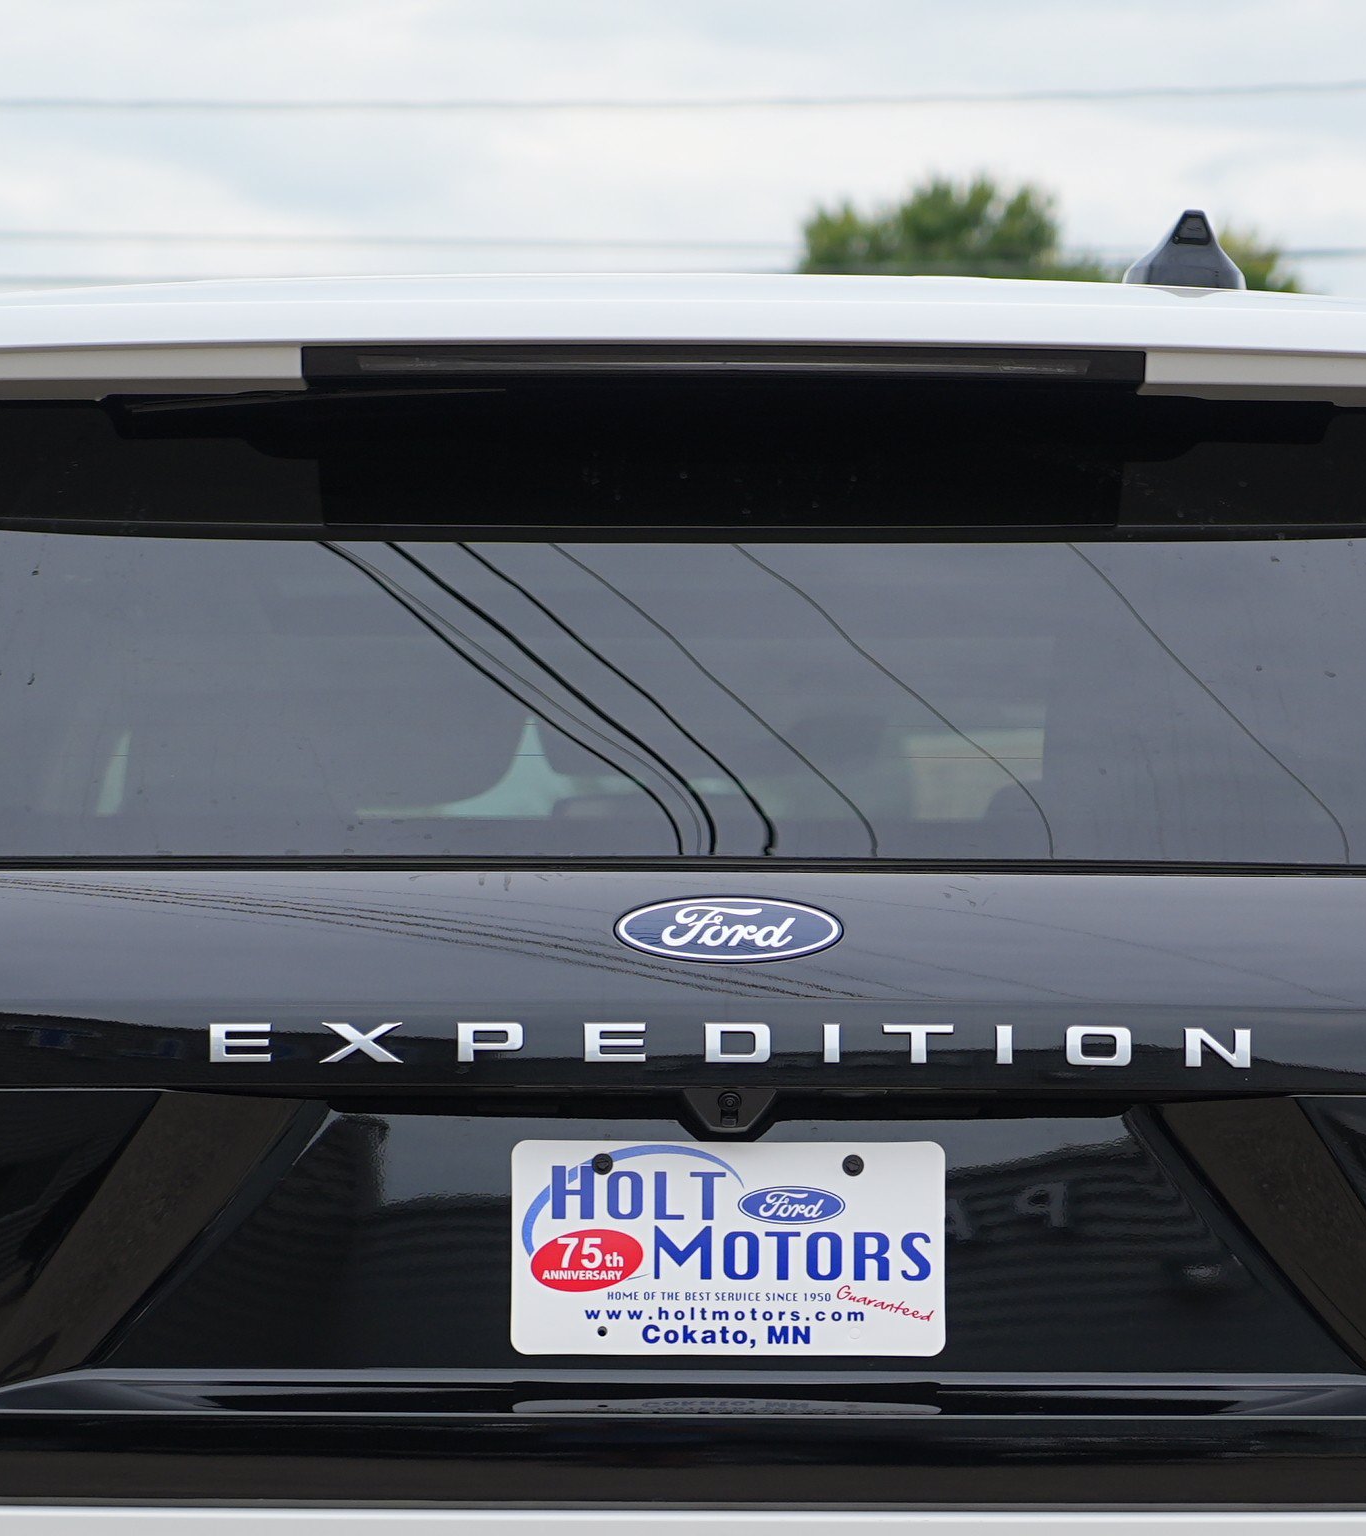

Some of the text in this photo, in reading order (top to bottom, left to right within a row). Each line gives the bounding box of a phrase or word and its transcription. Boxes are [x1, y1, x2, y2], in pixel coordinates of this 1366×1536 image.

[661, 905, 796, 948] Ford
[209, 1022, 1252, 1070] EXPEDITION
[551, 1165, 726, 1220] HOLT
[758, 1188, 823, 1219] Ford
[557, 1237, 624, 1268] 75th
[653, 1225, 931, 1281] MOTORS
[542, 1269, 623, 1282] ANNIVERSARY
[607, 1291, 831, 1302] HOME OF THE BEST SERVICE SINCE 1950
[836, 1285, 935, 1323] Guaranteed
[585, 1307, 865, 1322] www.holtmotors.com
[642, 1325, 811, 1348] Cokato, MN
